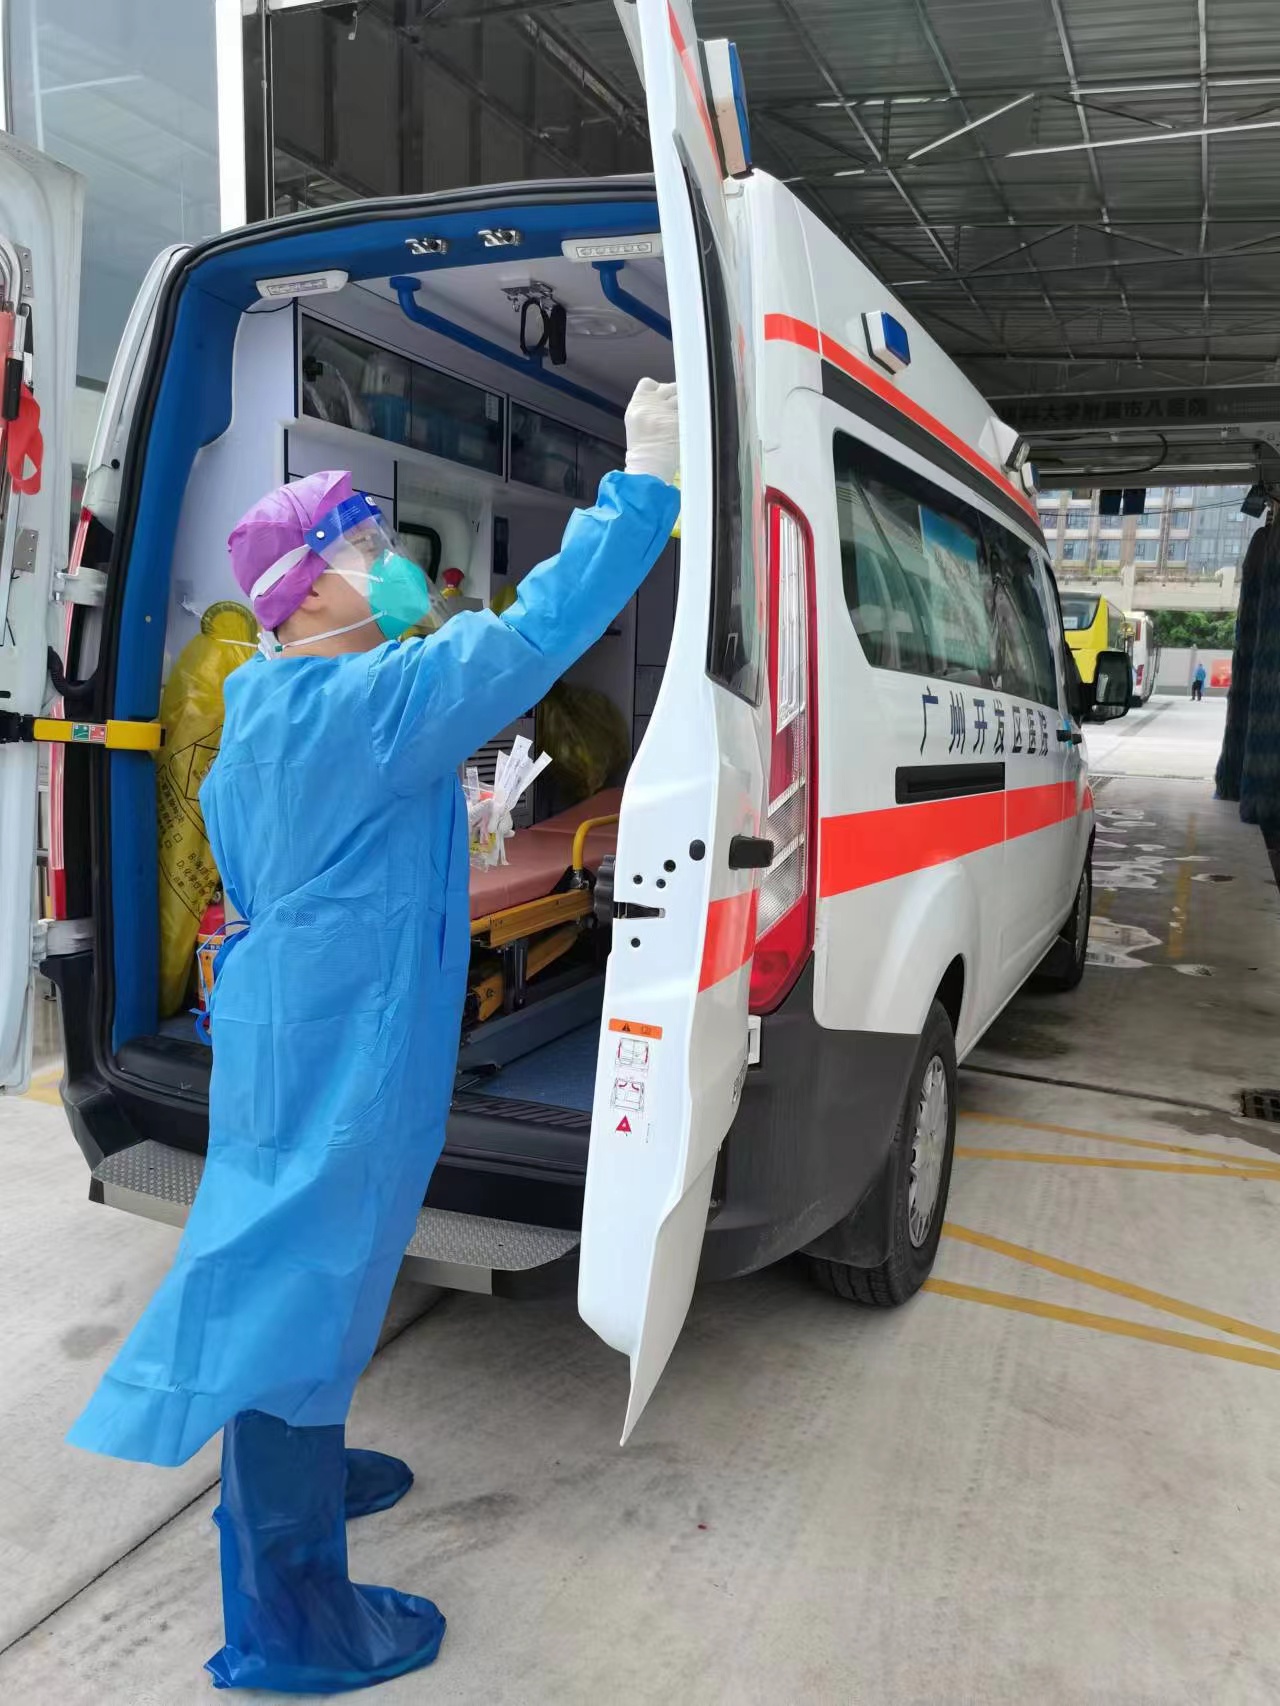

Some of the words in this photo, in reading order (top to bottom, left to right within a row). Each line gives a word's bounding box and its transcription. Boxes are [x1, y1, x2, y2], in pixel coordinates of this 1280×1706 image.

[919, 685, 1049, 756] 广州开发区医院
